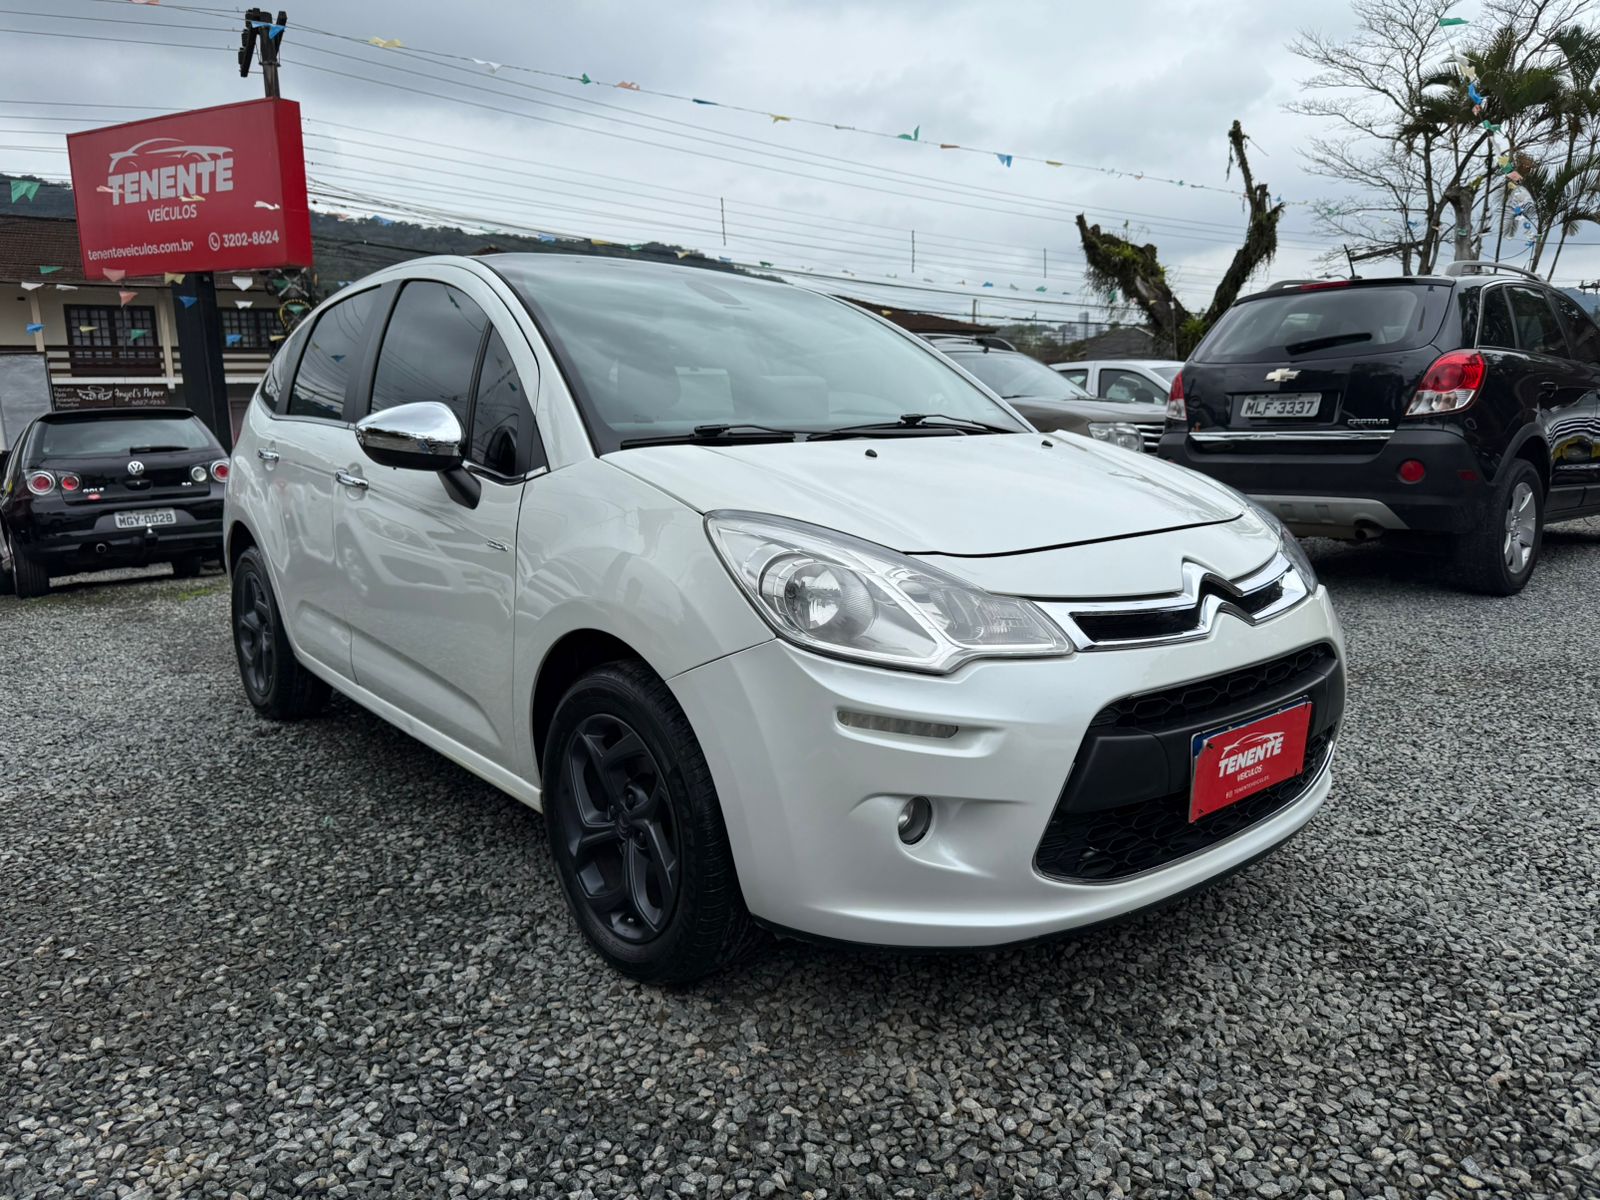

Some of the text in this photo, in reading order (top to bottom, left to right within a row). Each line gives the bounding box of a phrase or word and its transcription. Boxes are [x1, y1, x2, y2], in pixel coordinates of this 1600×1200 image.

[107, 157, 234, 206] TENENTE
[88, 238, 194, 261] tenenteveiculos.com.br
[223, 229, 280, 248] 3202-8624
[143, 387, 165, 400] Paper
[1218, 736, 1284, 778] TENENTE
